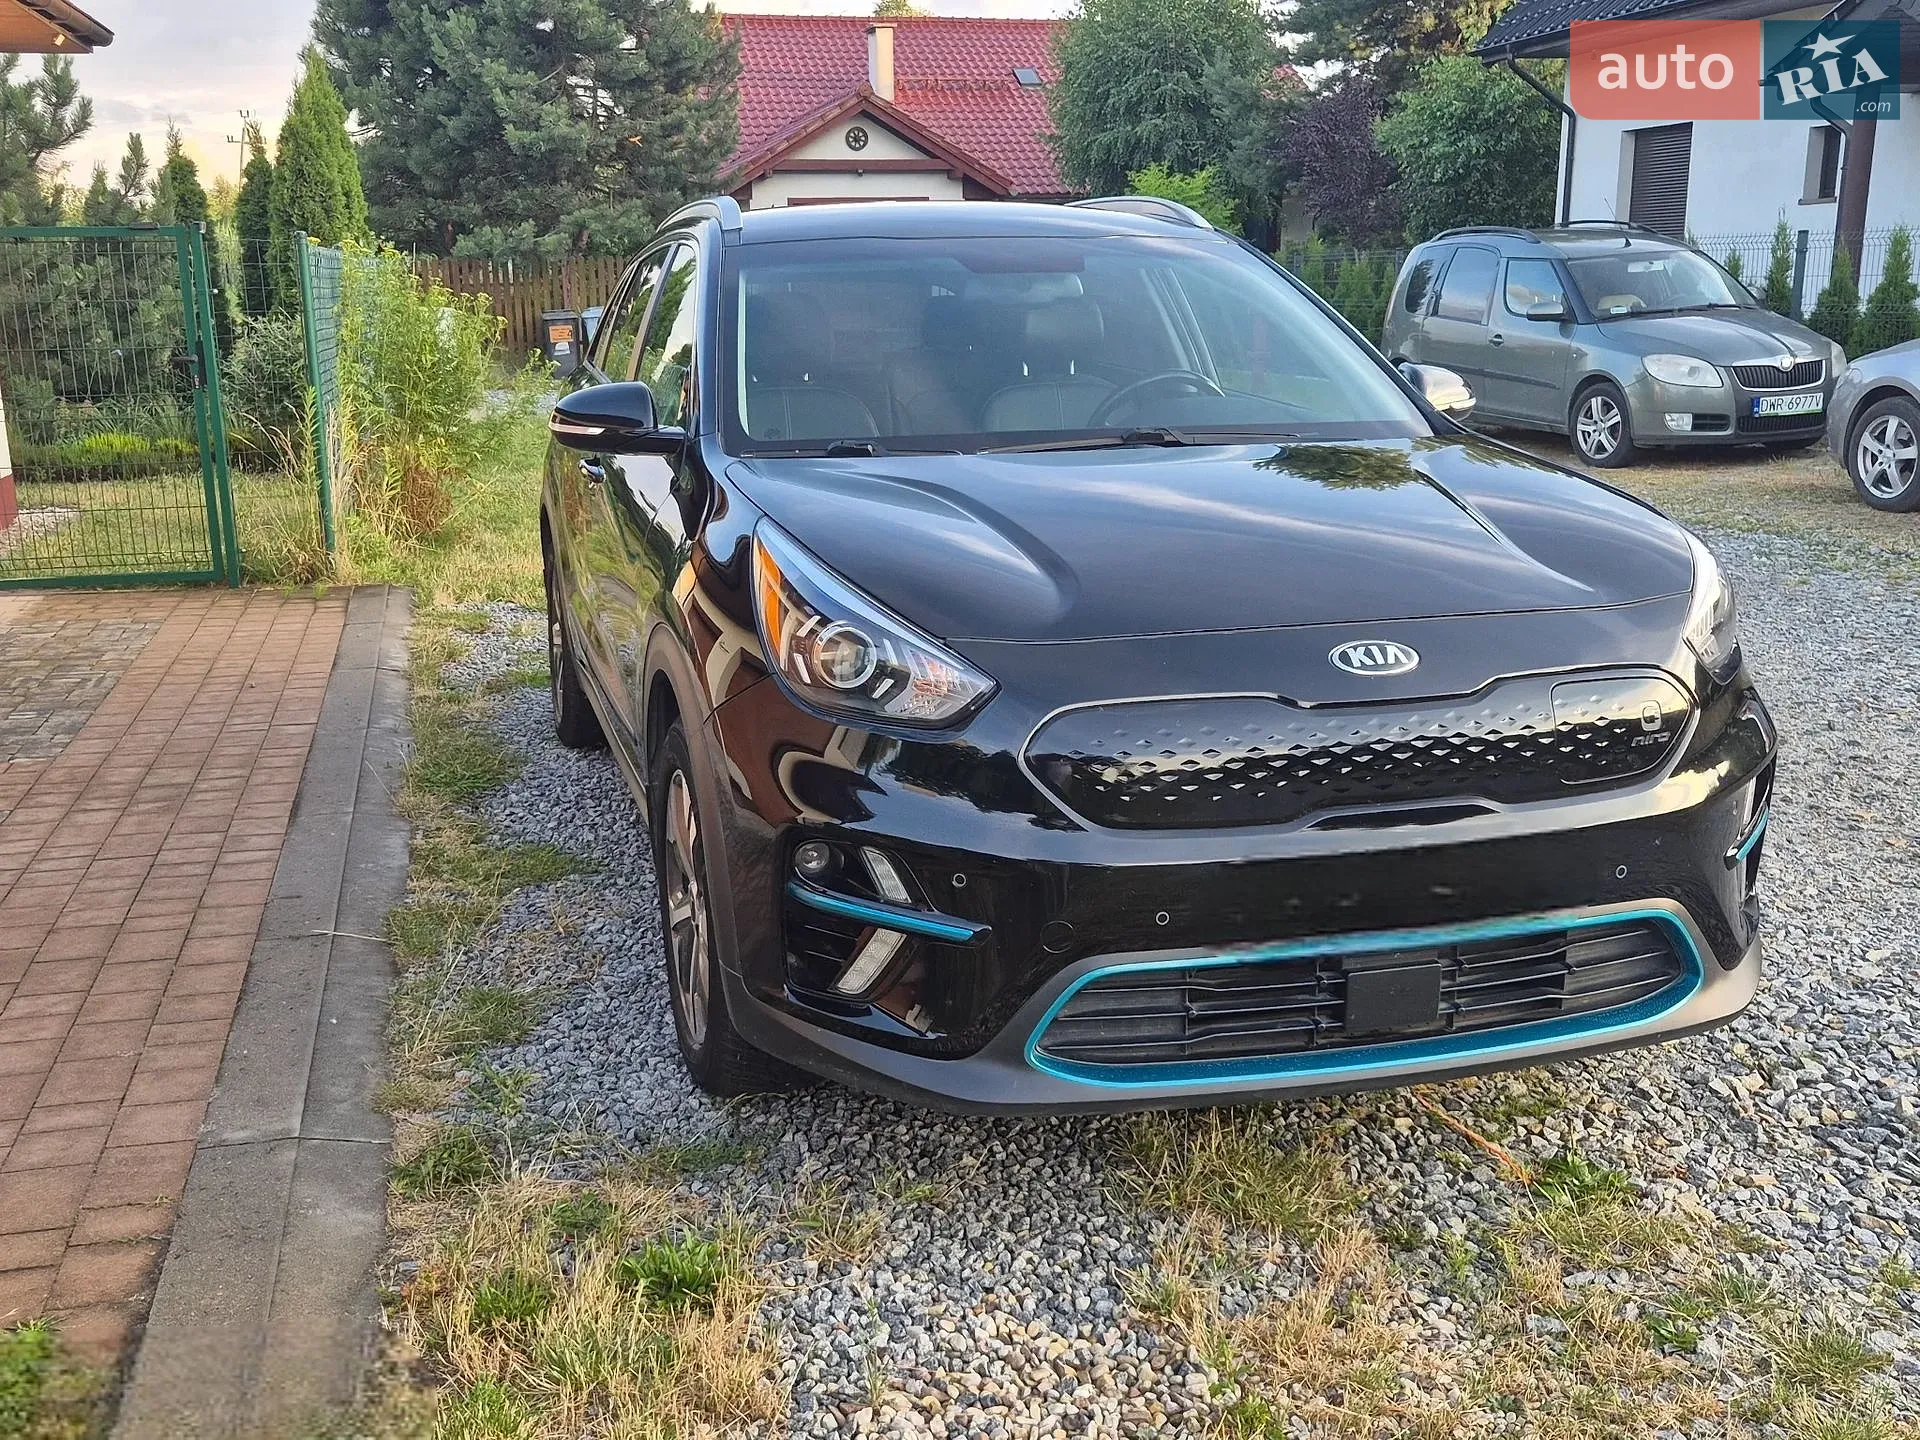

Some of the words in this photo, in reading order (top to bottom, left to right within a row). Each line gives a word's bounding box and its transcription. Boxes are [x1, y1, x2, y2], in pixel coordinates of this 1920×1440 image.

[1760, 397, 1784, 413] DWR
[1787, 394, 1821, 411] 6977V
[1344, 644, 1409, 668] KIA
